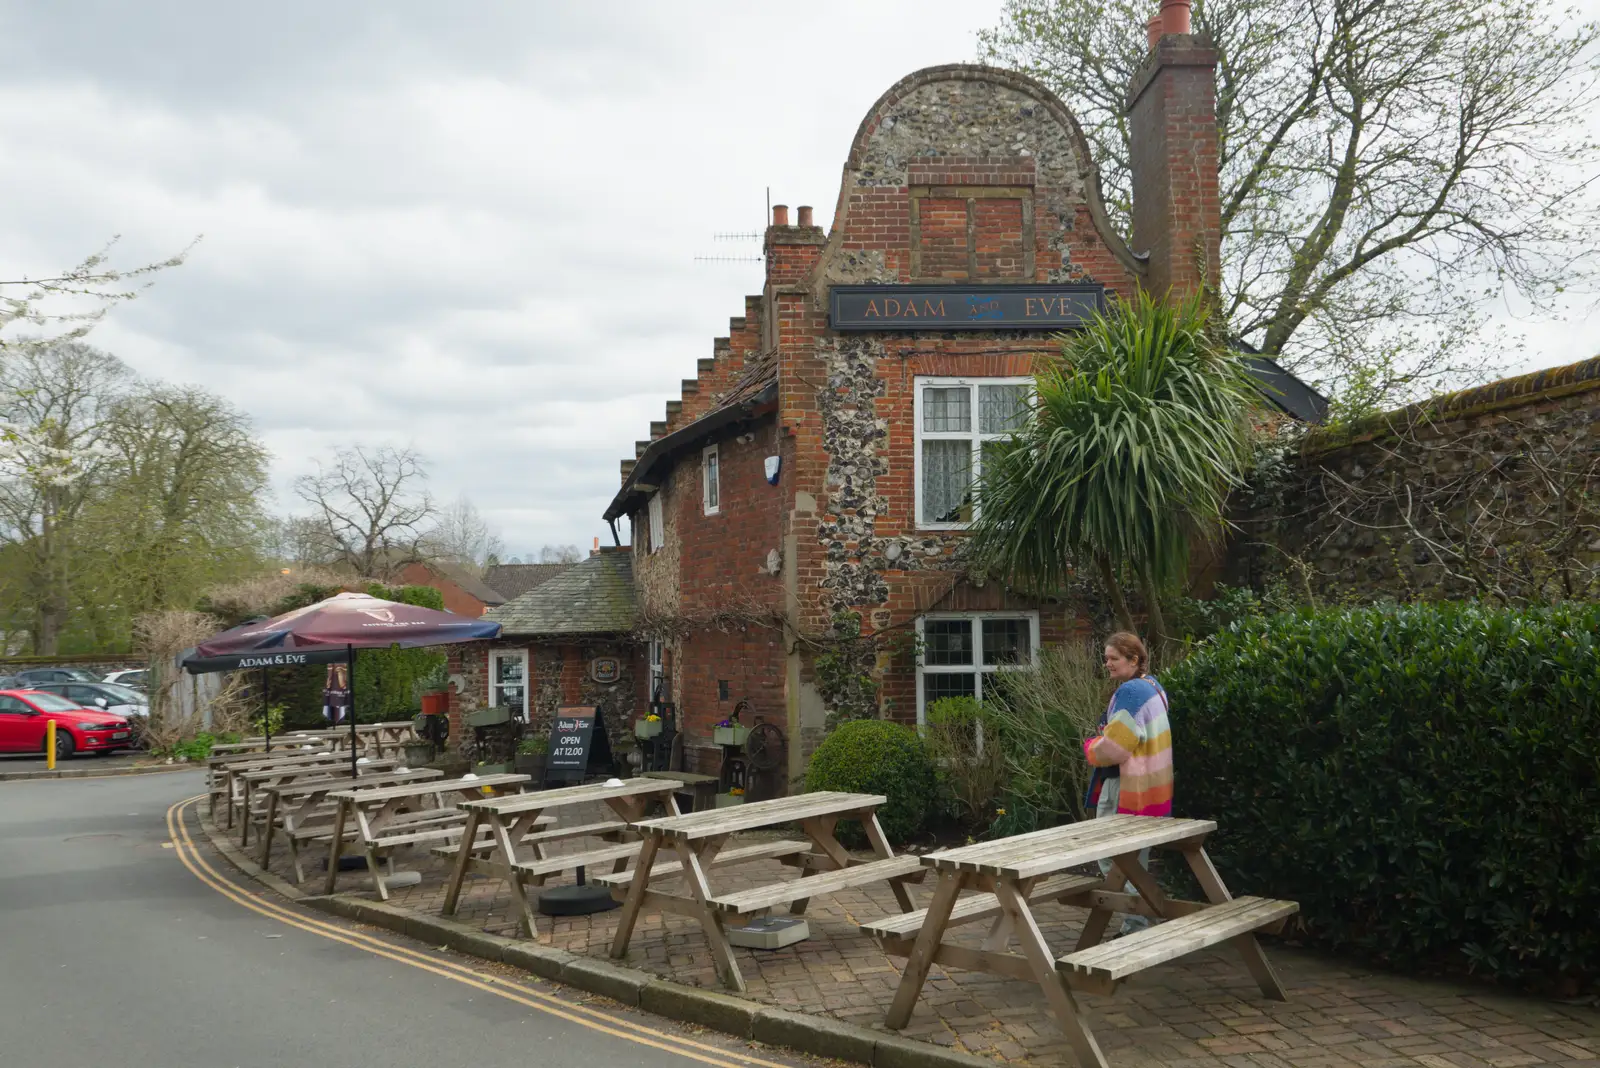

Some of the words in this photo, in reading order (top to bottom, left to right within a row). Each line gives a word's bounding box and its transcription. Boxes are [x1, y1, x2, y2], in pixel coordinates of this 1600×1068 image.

[864, 299, 947, 318] ADAM
[1024, 297, 1073, 317] EVE
[238, 657, 273, 668] ADAM
[274, 655, 284, 664] &
[285, 654, 307, 664] EVE
[560, 736, 581, 745] OPEN
[553, 747, 564, 756] AT
[564, 747, 583, 756] 12.00
